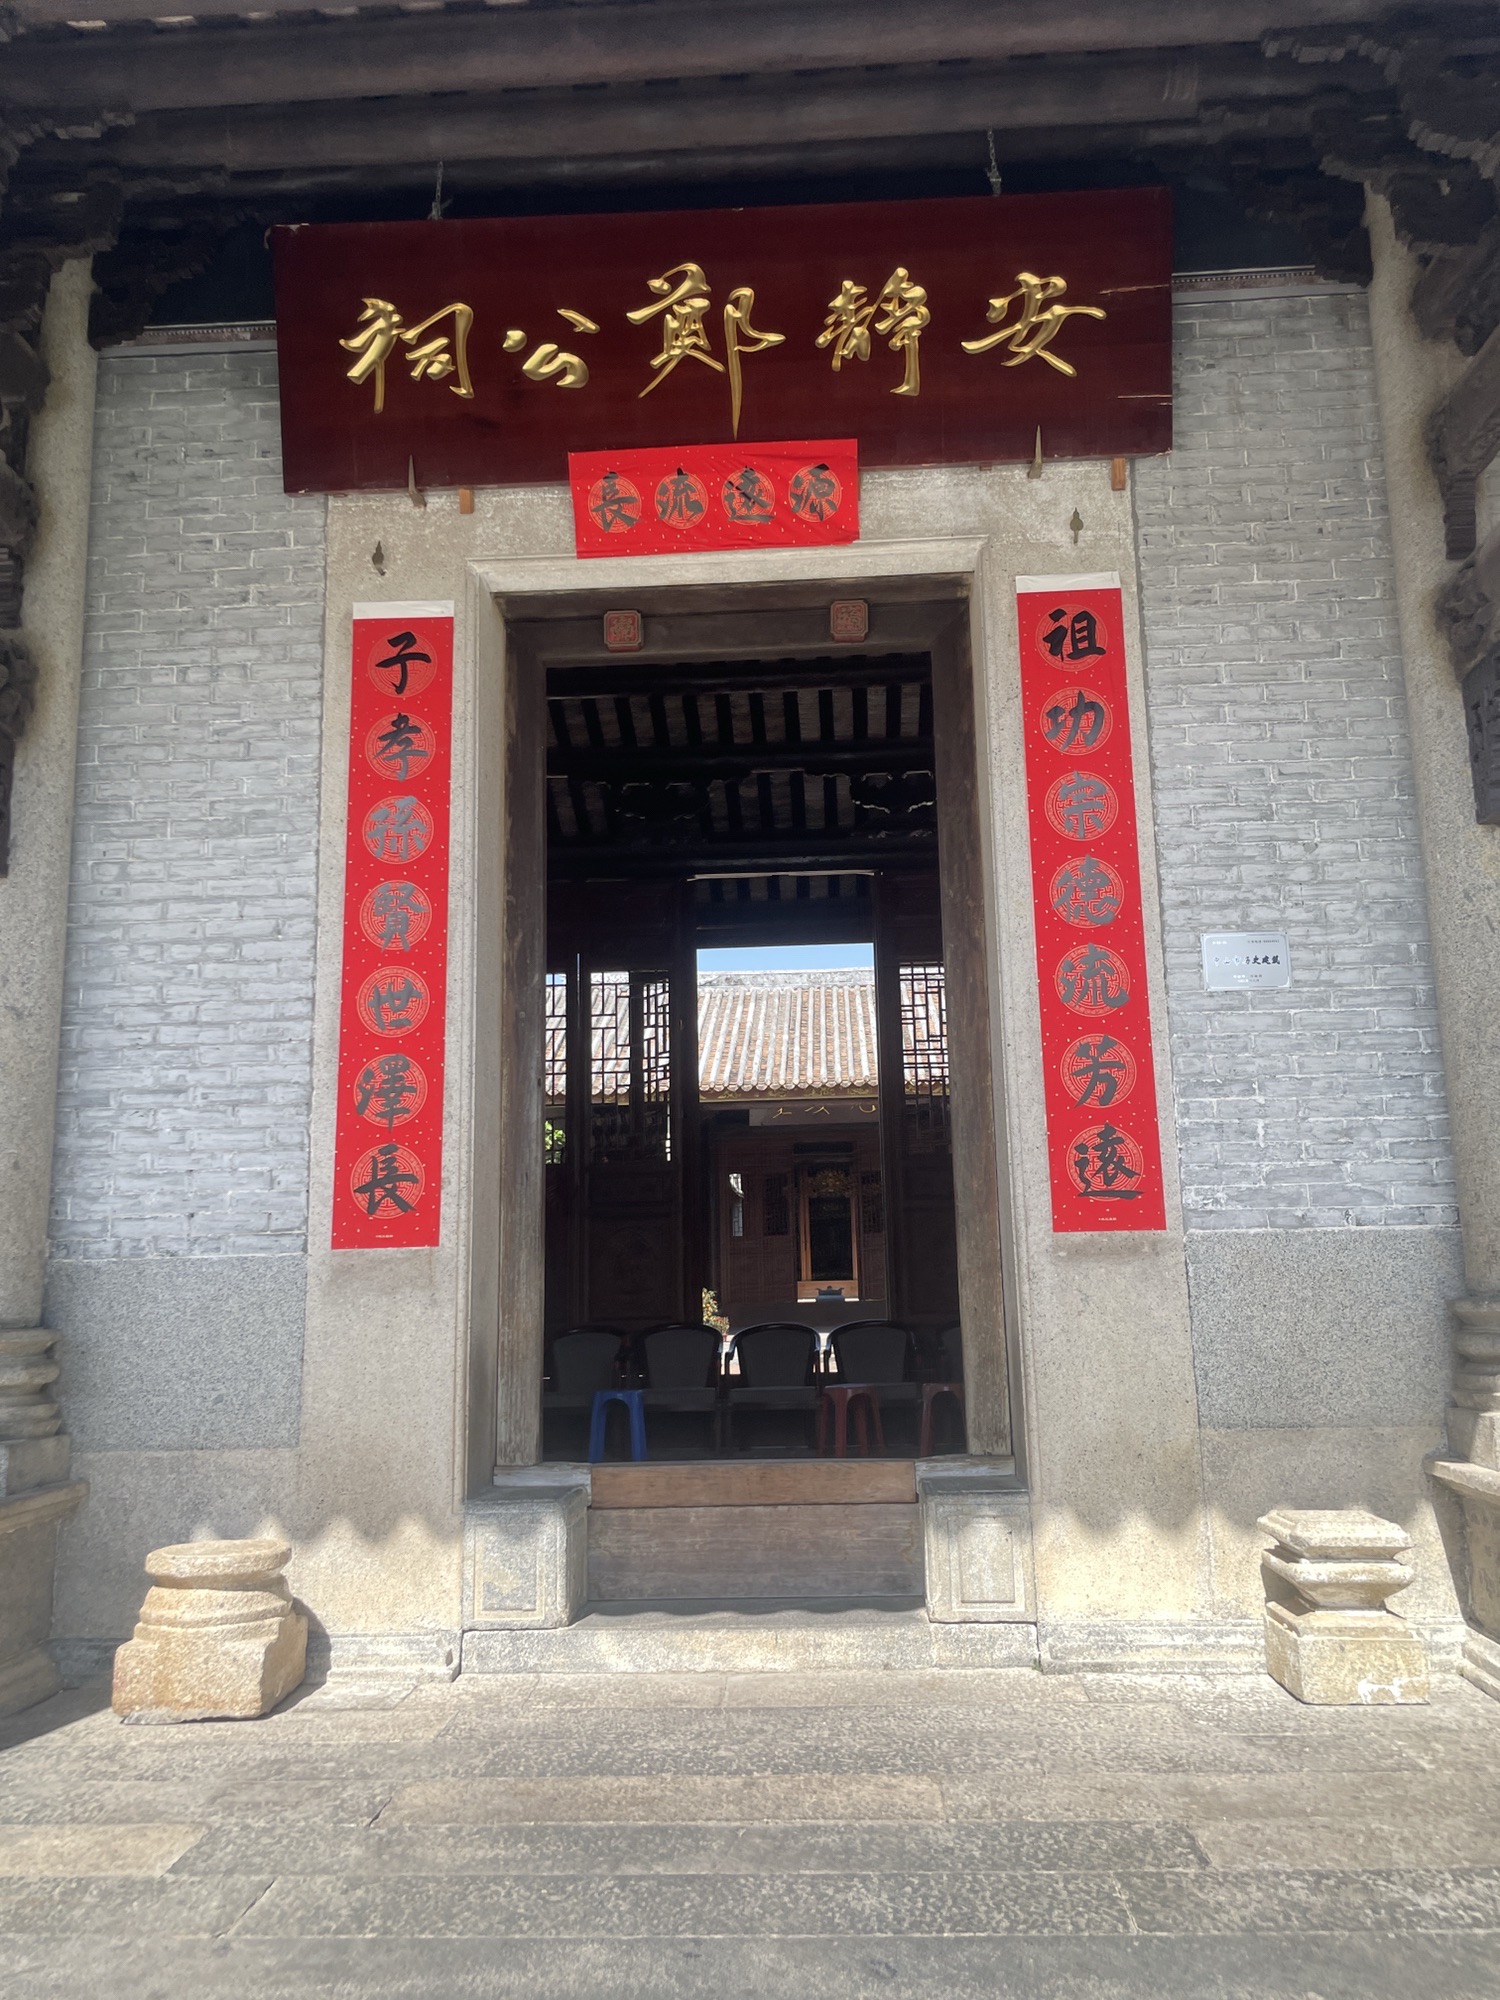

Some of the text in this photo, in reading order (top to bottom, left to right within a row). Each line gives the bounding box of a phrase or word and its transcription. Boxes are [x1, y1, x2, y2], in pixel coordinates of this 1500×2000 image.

[591, 463, 838, 533] 源遠流長
[353, 631, 432, 1215] 子孝孫賢世澤長
[1043, 606, 1145, 1200] 祖功宗德流芳遠
